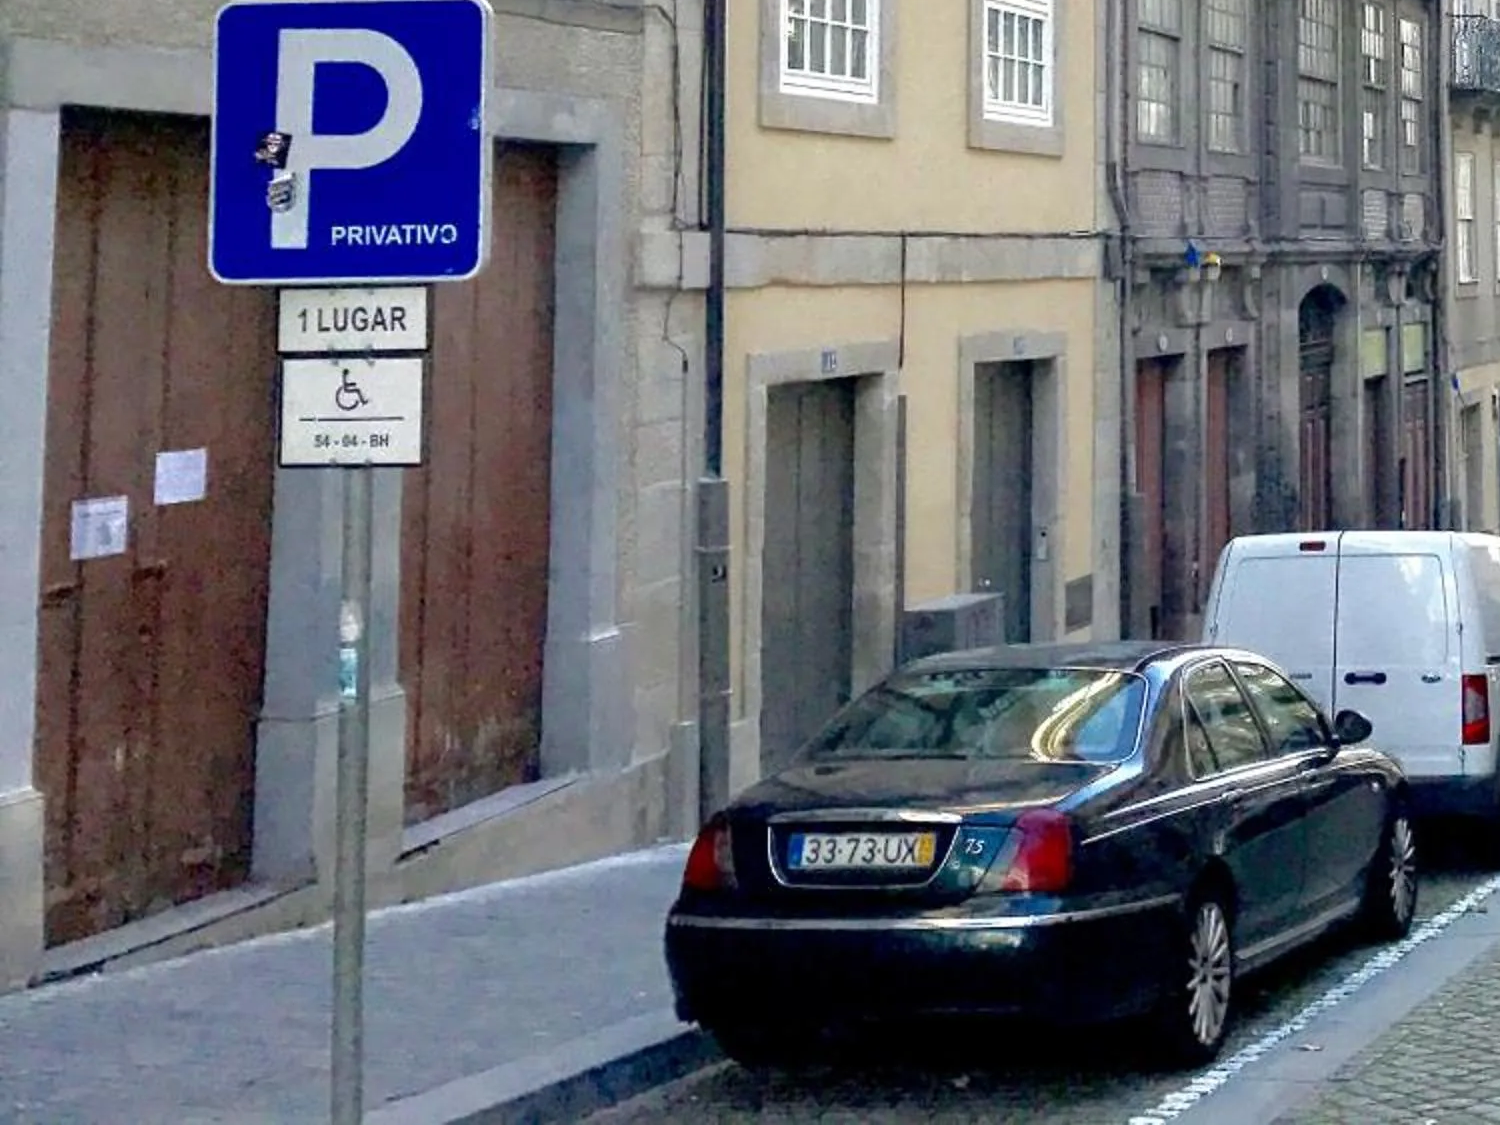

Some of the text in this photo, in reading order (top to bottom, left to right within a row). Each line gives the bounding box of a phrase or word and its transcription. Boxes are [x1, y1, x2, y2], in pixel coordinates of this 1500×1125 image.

[270, 28, 423, 249] P
[331, 224, 457, 247] PRIVATIVO
[298, 307, 406, 333] 1 LUGAR
[965, 838, 985, 854] 75
